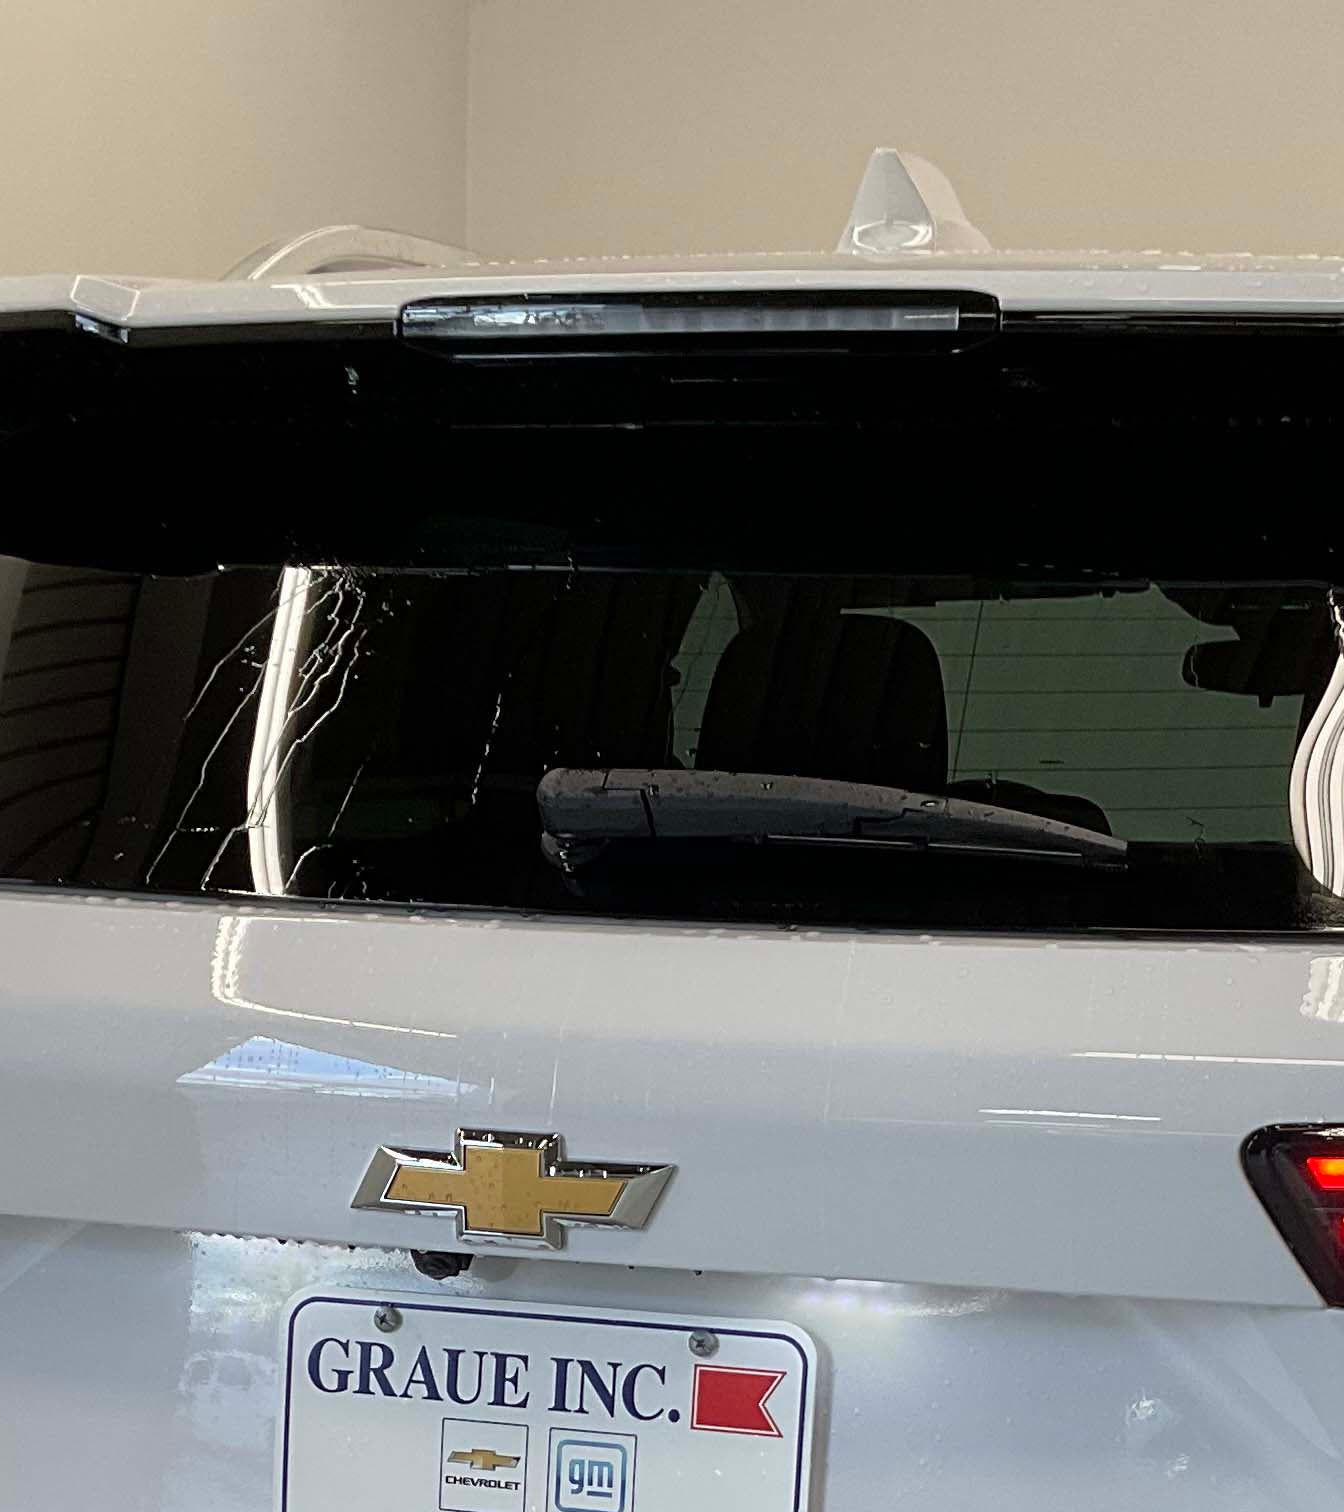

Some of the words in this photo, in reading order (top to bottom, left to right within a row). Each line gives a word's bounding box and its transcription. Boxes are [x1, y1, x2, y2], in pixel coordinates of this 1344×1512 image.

[307, 1336, 529, 1409] GRAUE
[548, 1356, 681, 1424] INC.
[444, 1475, 521, 1491] CHEVROLET
[567, 1460, 613, 1495] gm
